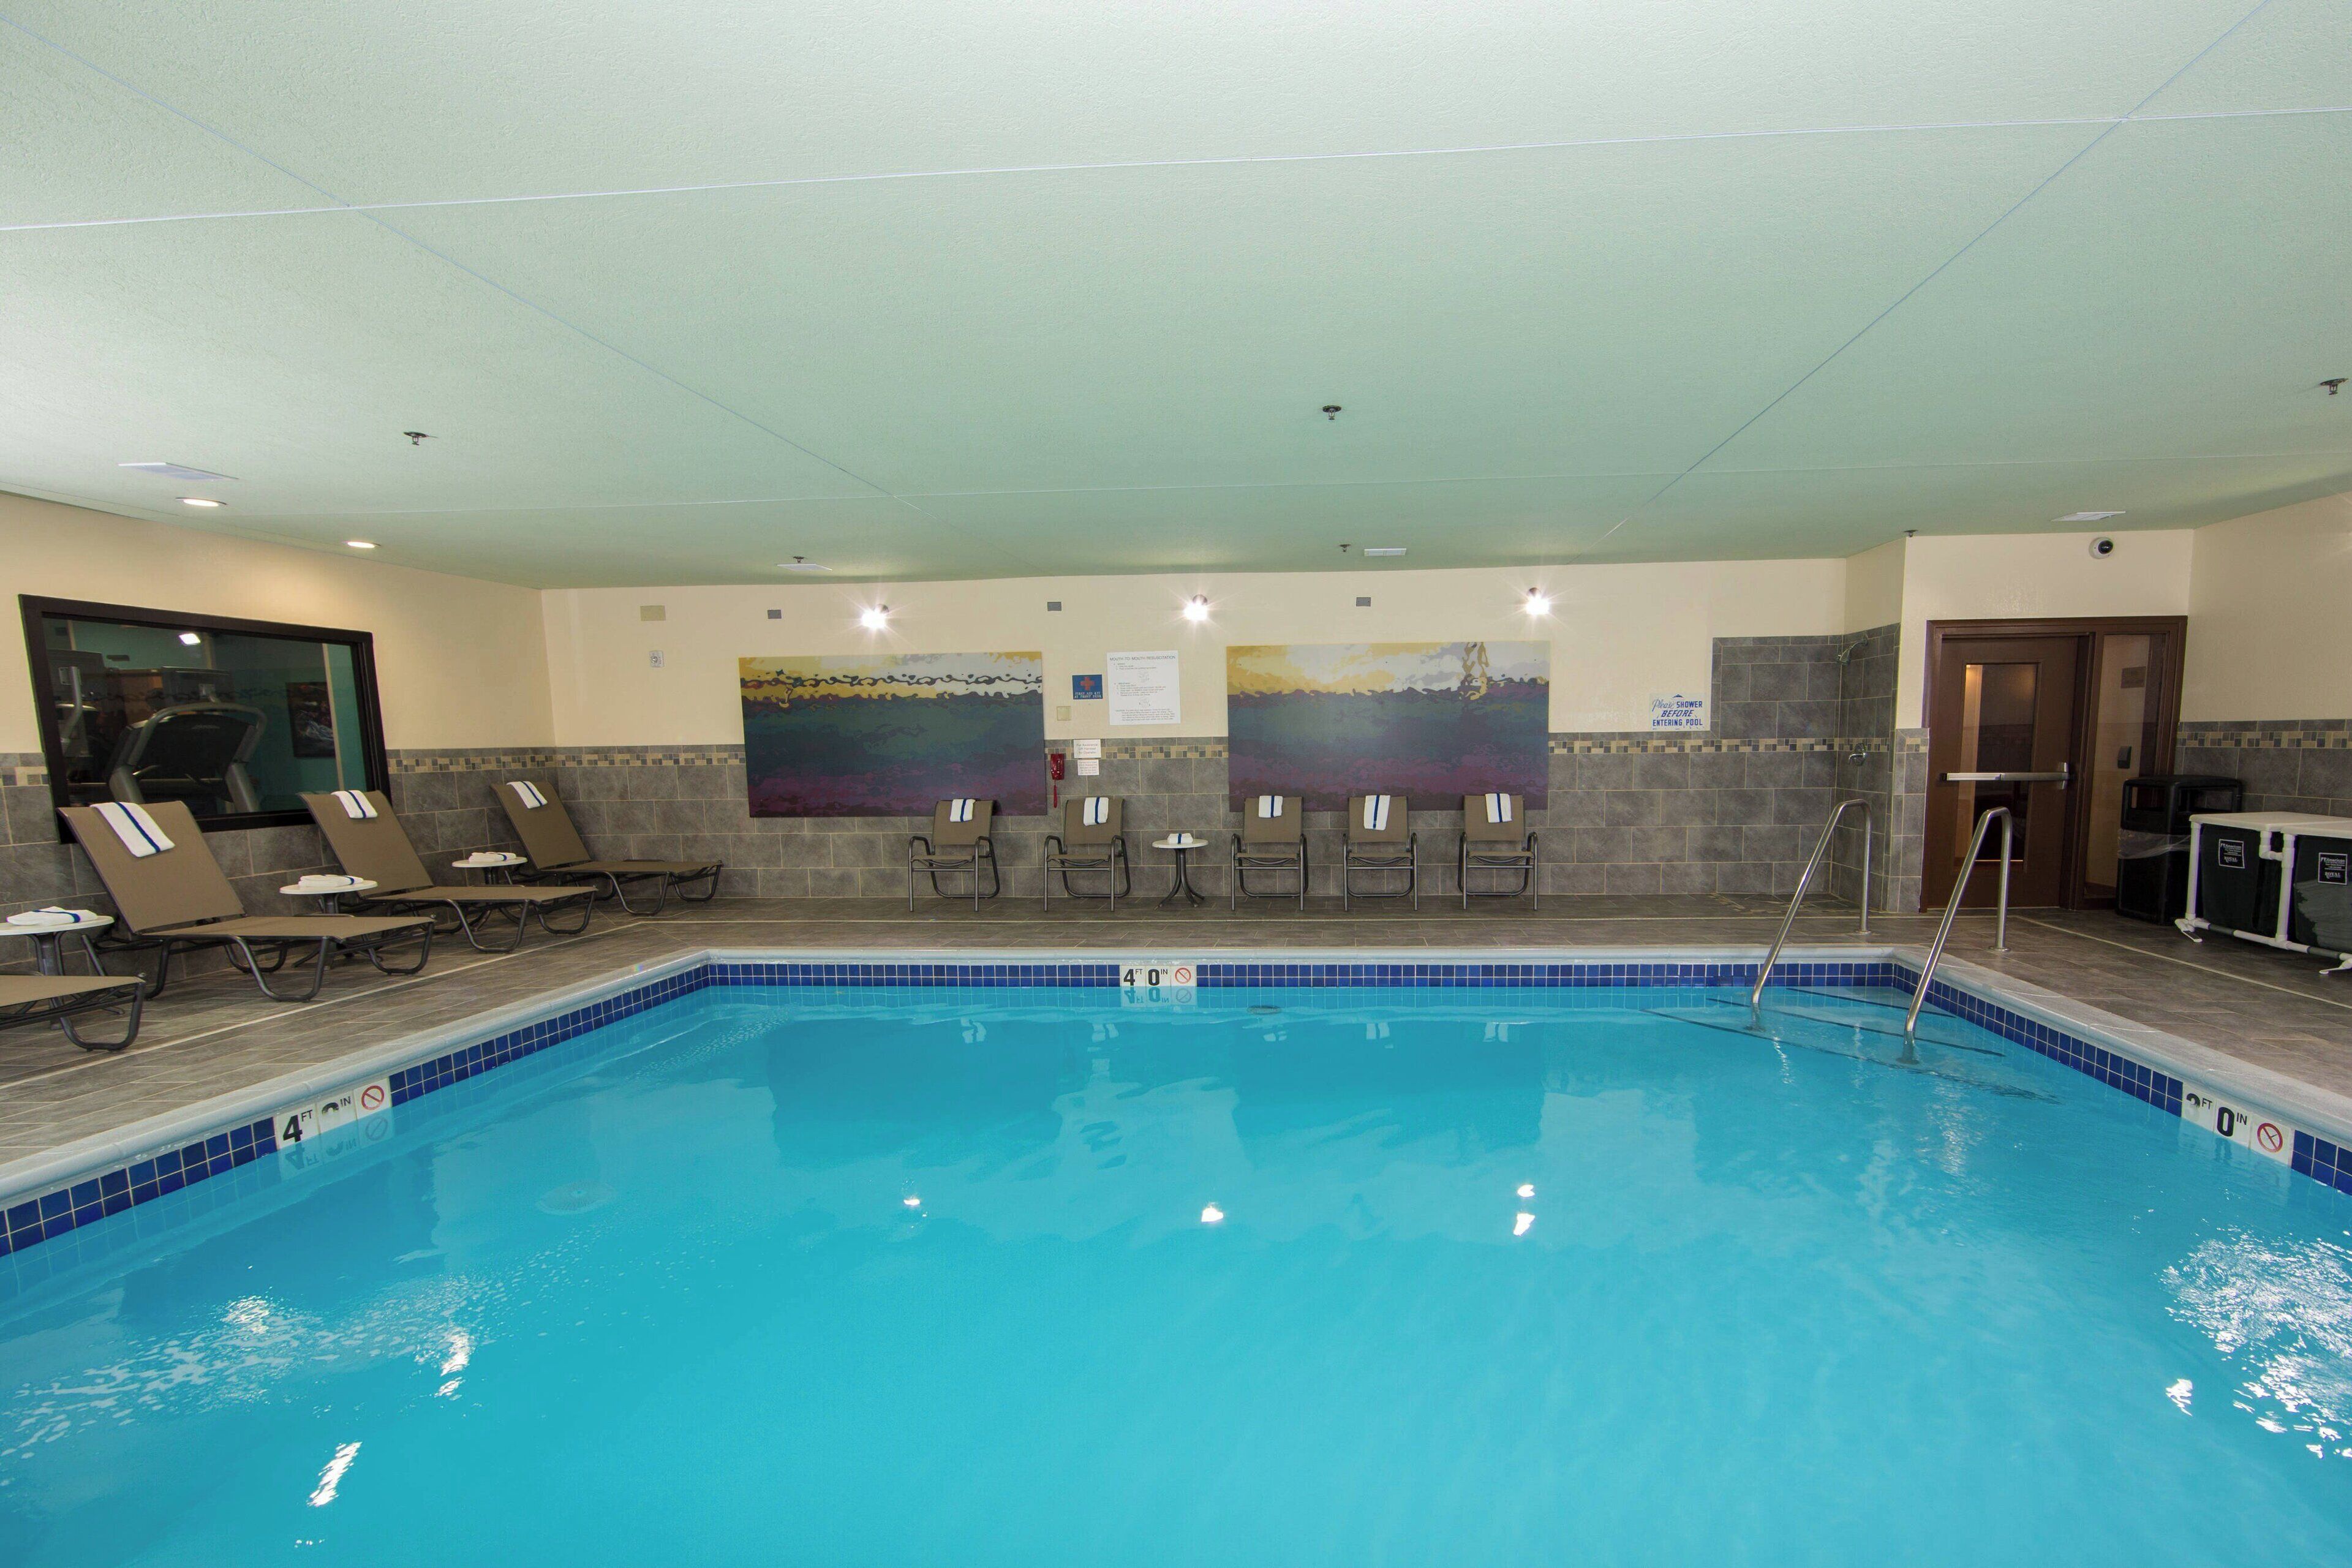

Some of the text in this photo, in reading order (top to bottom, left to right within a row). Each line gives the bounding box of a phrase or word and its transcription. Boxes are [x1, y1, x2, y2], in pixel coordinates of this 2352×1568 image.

[1123, 968, 1136, 986] 4
[1148, 968, 1160, 986] 0
[282, 1096, 351, 1143] 4 FT IN
[2201, 1098, 2212, 1109] FT
[2217, 1106, 2234, 1137] 0
[2236, 1112, 2247, 1125] IN
